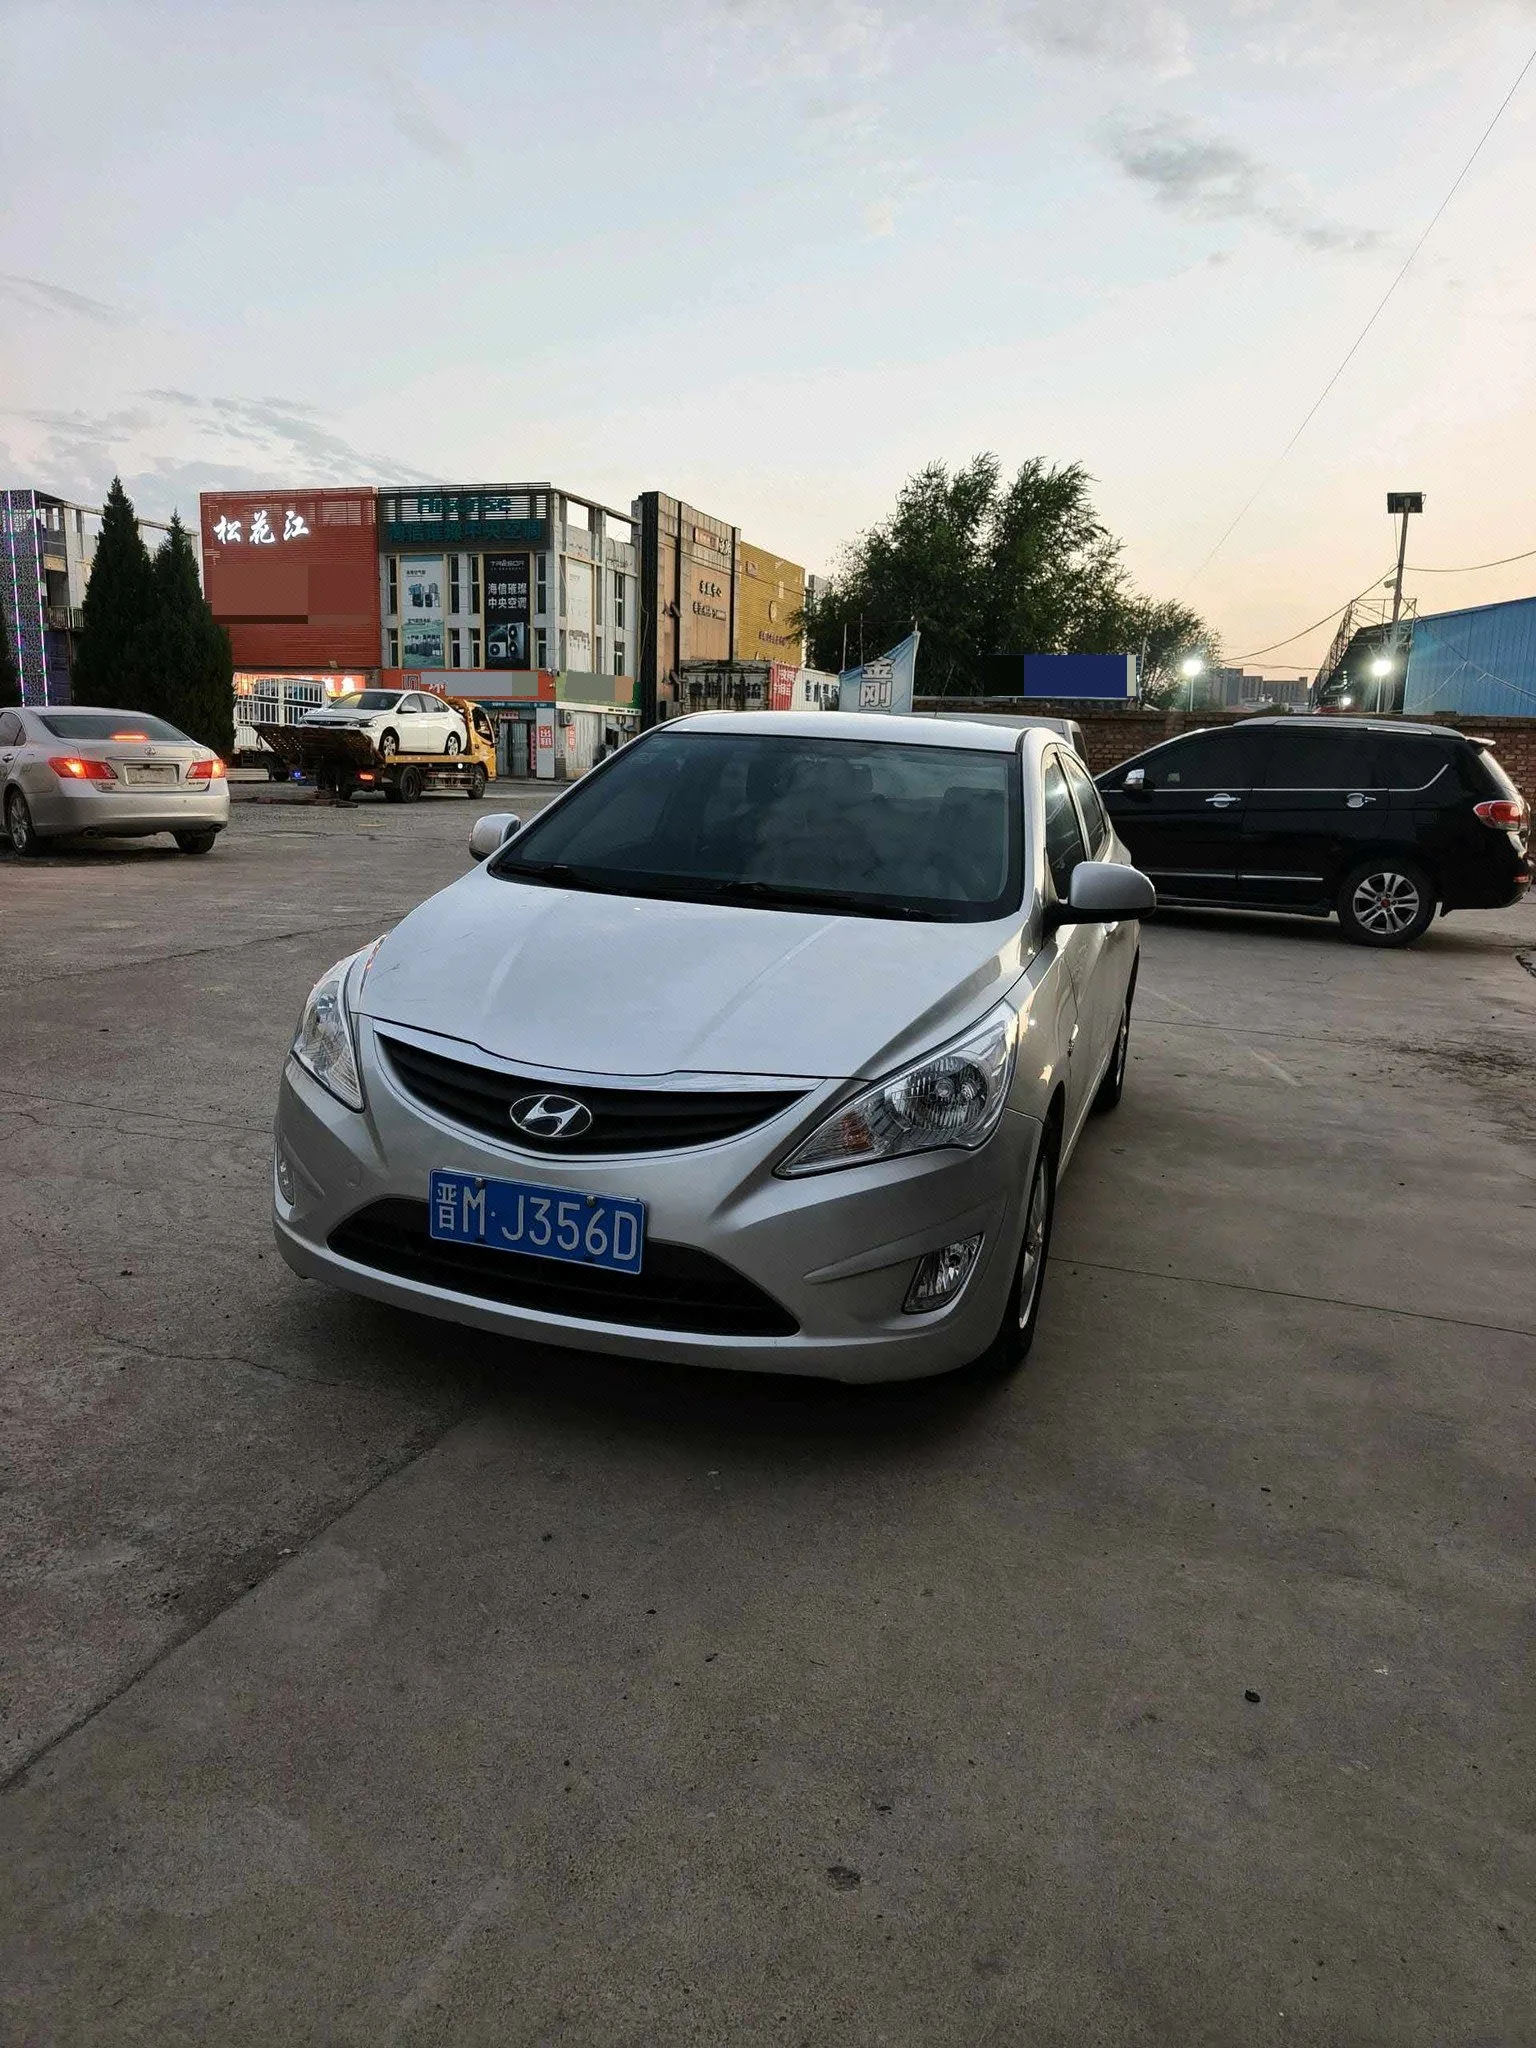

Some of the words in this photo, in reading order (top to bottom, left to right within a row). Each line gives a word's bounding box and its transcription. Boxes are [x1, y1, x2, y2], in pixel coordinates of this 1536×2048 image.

[213, 509, 310, 545] 松花江
[487, 582, 527, 596] 海信璀璨
[487, 597, 527, 610] 中央空调
[859, 656, 895, 713] 金刚
